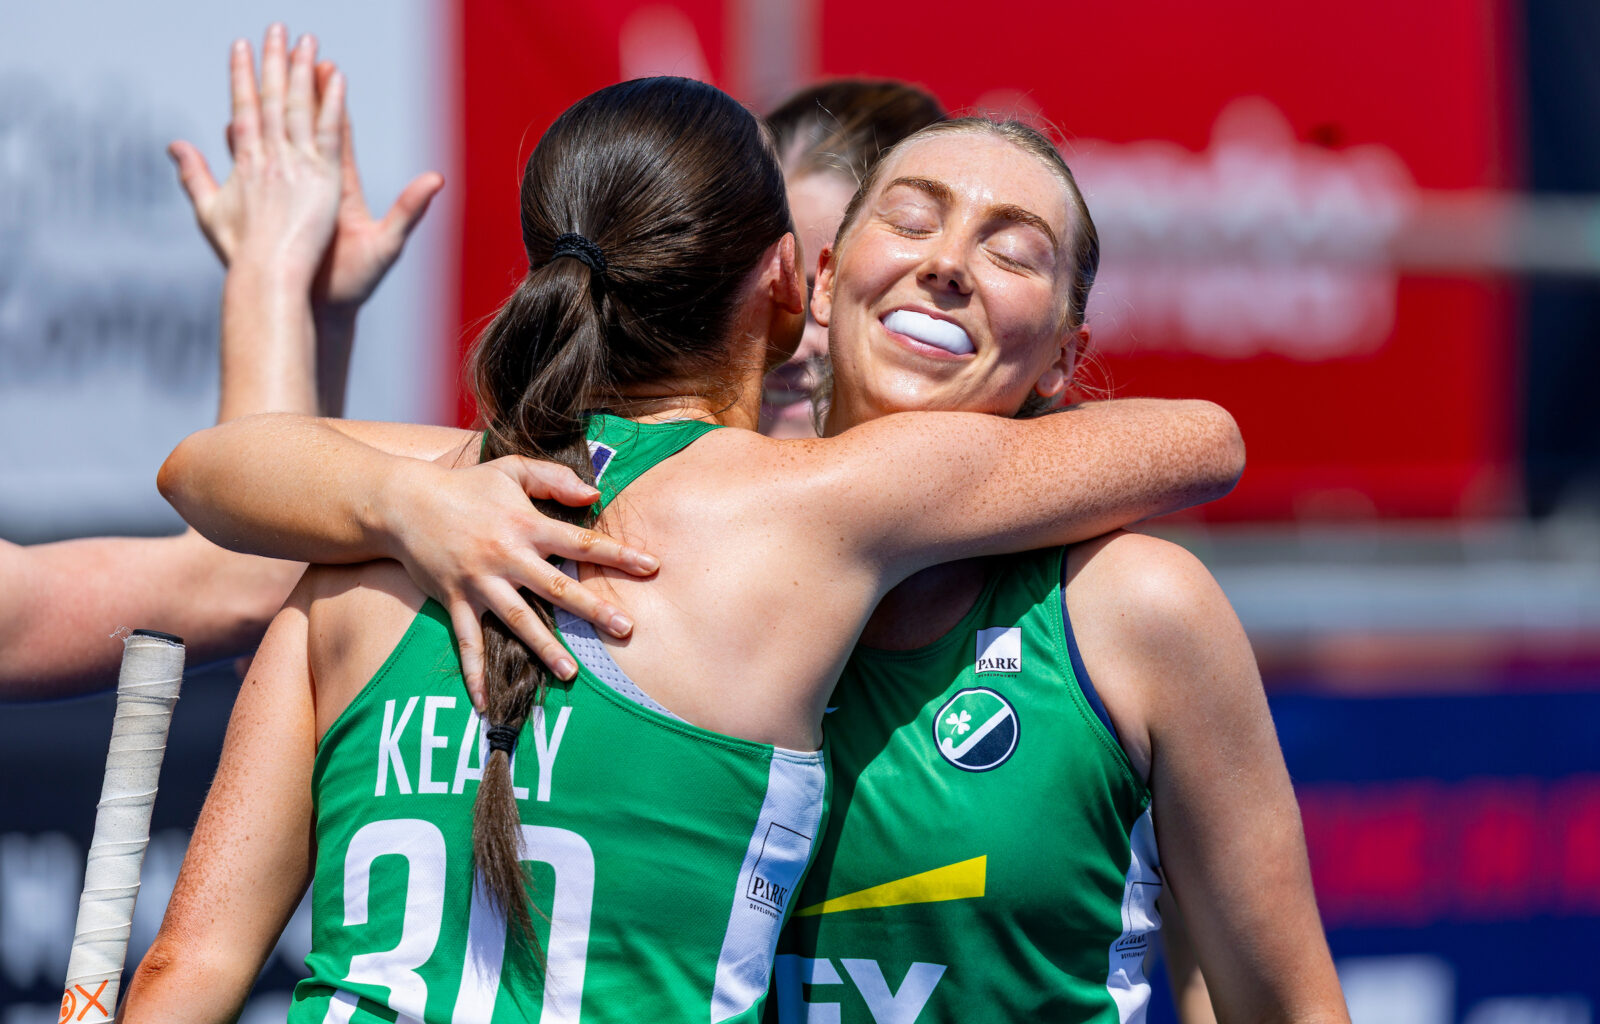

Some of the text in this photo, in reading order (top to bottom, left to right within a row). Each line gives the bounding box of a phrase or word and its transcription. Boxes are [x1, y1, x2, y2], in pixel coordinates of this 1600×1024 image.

[978, 657, 1018, 670] PARK
[752, 876, 788, 907] PARK
[322, 817, 596, 1024] 30
[774, 953, 948, 1024] EY
